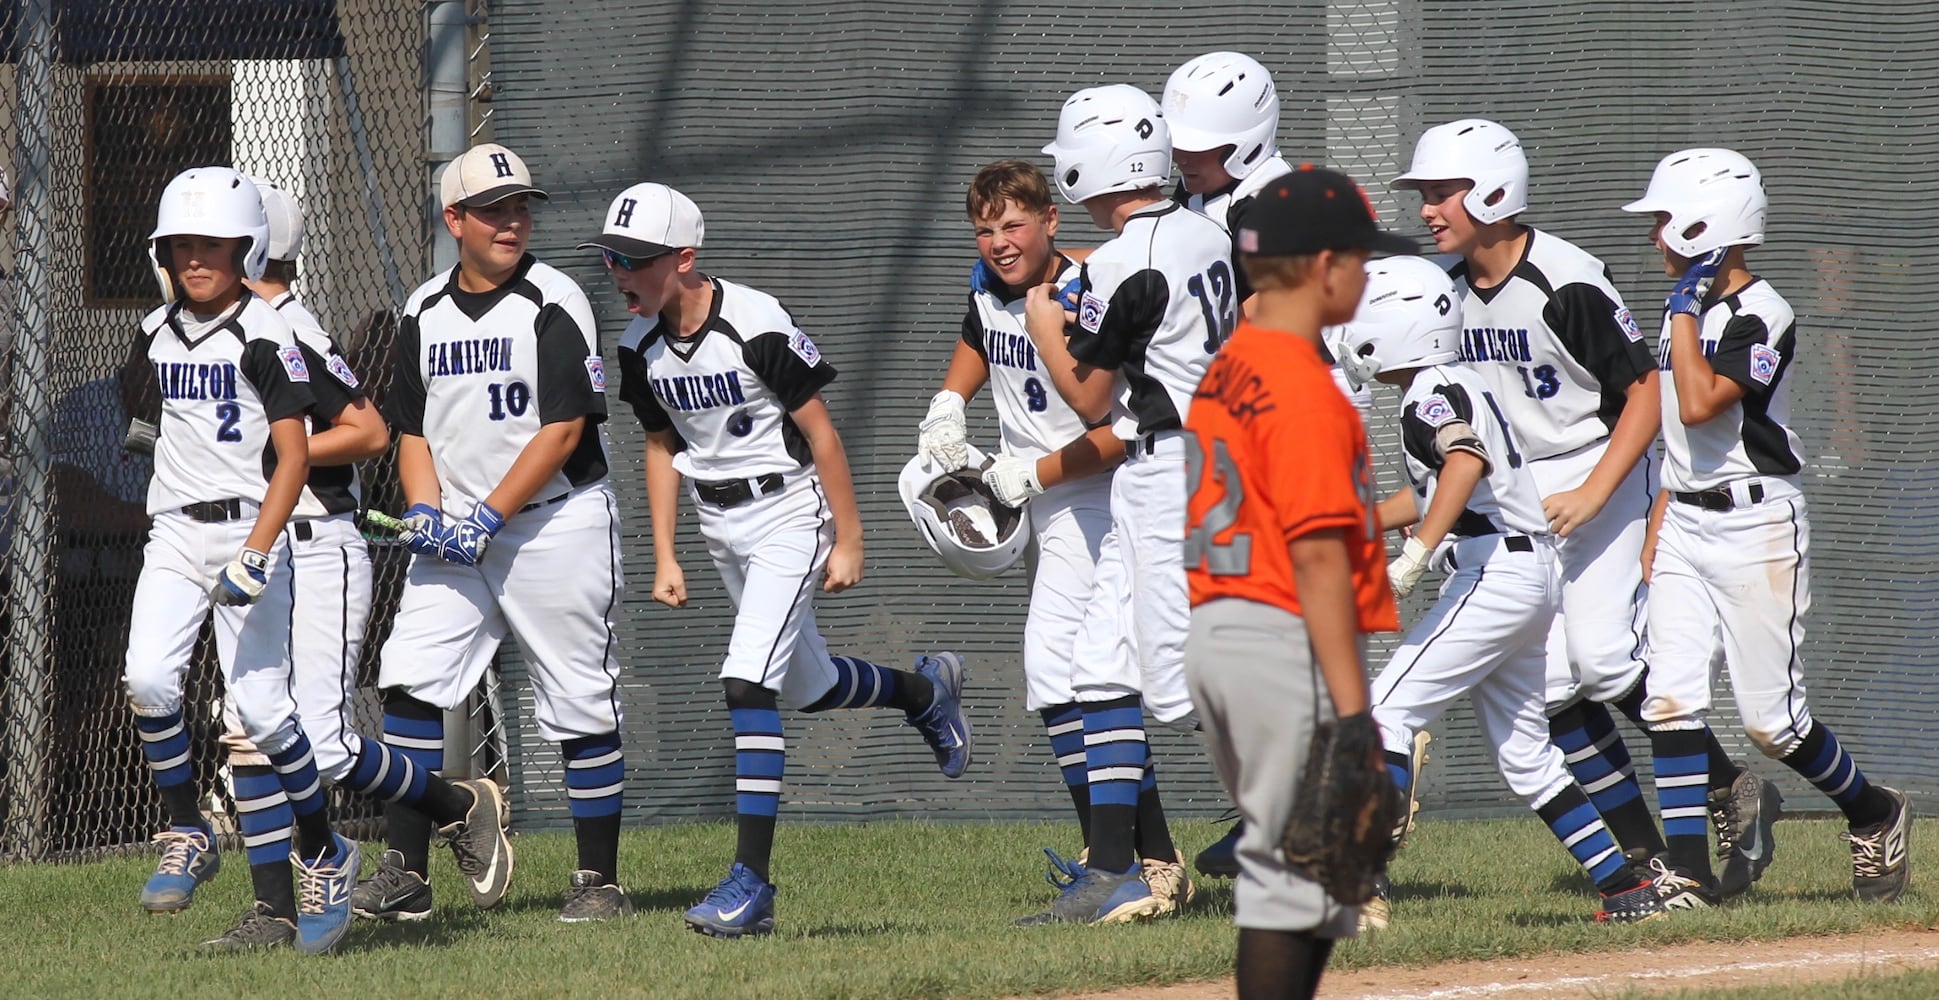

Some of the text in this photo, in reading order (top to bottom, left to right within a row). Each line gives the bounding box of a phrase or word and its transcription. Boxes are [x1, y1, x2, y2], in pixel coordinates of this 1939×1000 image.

[490, 153, 514, 178] H
[1130, 162, 1144, 173] 12
[614, 198, 638, 228] H
[1187, 260, 1235, 354] 12
[428, 336, 514, 377] HAMILTON
[1433, 338, 1440, 349] 1
[155, 362, 238, 400] AMILTON
[1024, 377, 1048, 413] 9
[1516, 364, 1562, 400] 13
[487, 381, 532, 421] 10
[215, 402, 243, 442] 2
